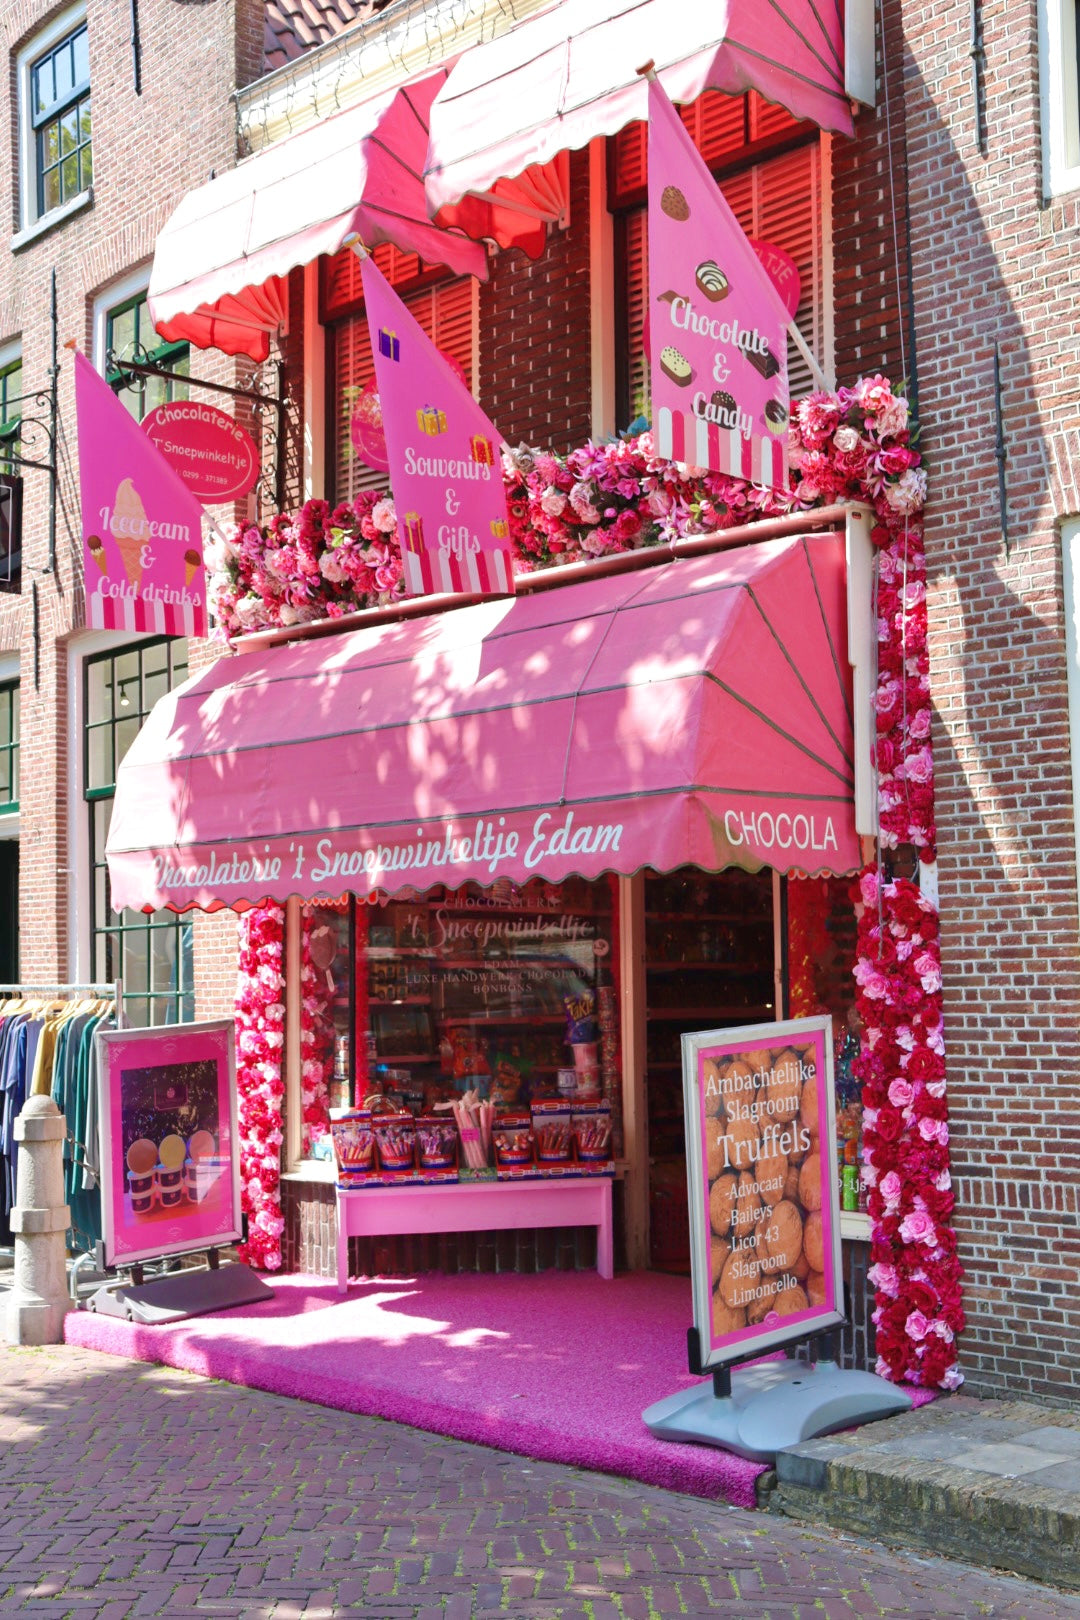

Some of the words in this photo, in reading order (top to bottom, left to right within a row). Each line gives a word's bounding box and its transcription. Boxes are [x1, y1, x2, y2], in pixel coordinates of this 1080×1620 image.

[670, 297, 769, 357] Chocolate
[712, 352, 732, 384] &
[155, 405, 244, 442] Chocolaterie
[693, 391, 753, 441] Candy
[164, 441, 248, 470] Snoepwinkeltje
[404, 447, 491, 481] Souvenirs
[445, 487, 461, 517] &
[99, 506, 190, 542] Icecream
[139, 544, 157, 570] &
[437, 525, 481, 562] Gifts
[97, 575, 138, 601] Cold
[142, 582, 202, 607] drinks
[724, 809, 838, 851] CHOCOLA
[154, 843, 282, 889] Chocolaterie
[289, 841, 306, 879] 't
[310, 816, 520, 886] Snoepwinkeltje
[523, 811, 624, 869] Edam
[405, 974, 439, 984] LUXE
[473, 983, 533, 994] BONBONS
[705, 1059, 816, 1097] Ambachtelijke
[726, 1095, 800, 1124] Slagroom
[716, 1119, 811, 1169] Truffels
[725, 1174, 784, 1200] -Advocaat
[725, 1204, 773, 1226] -Baileys
[764, 1225, 780, 1243] 43
[727, 1252, 787, 1279] -Slagroom
[728, 1273, 798, 1306] -Limoncello
